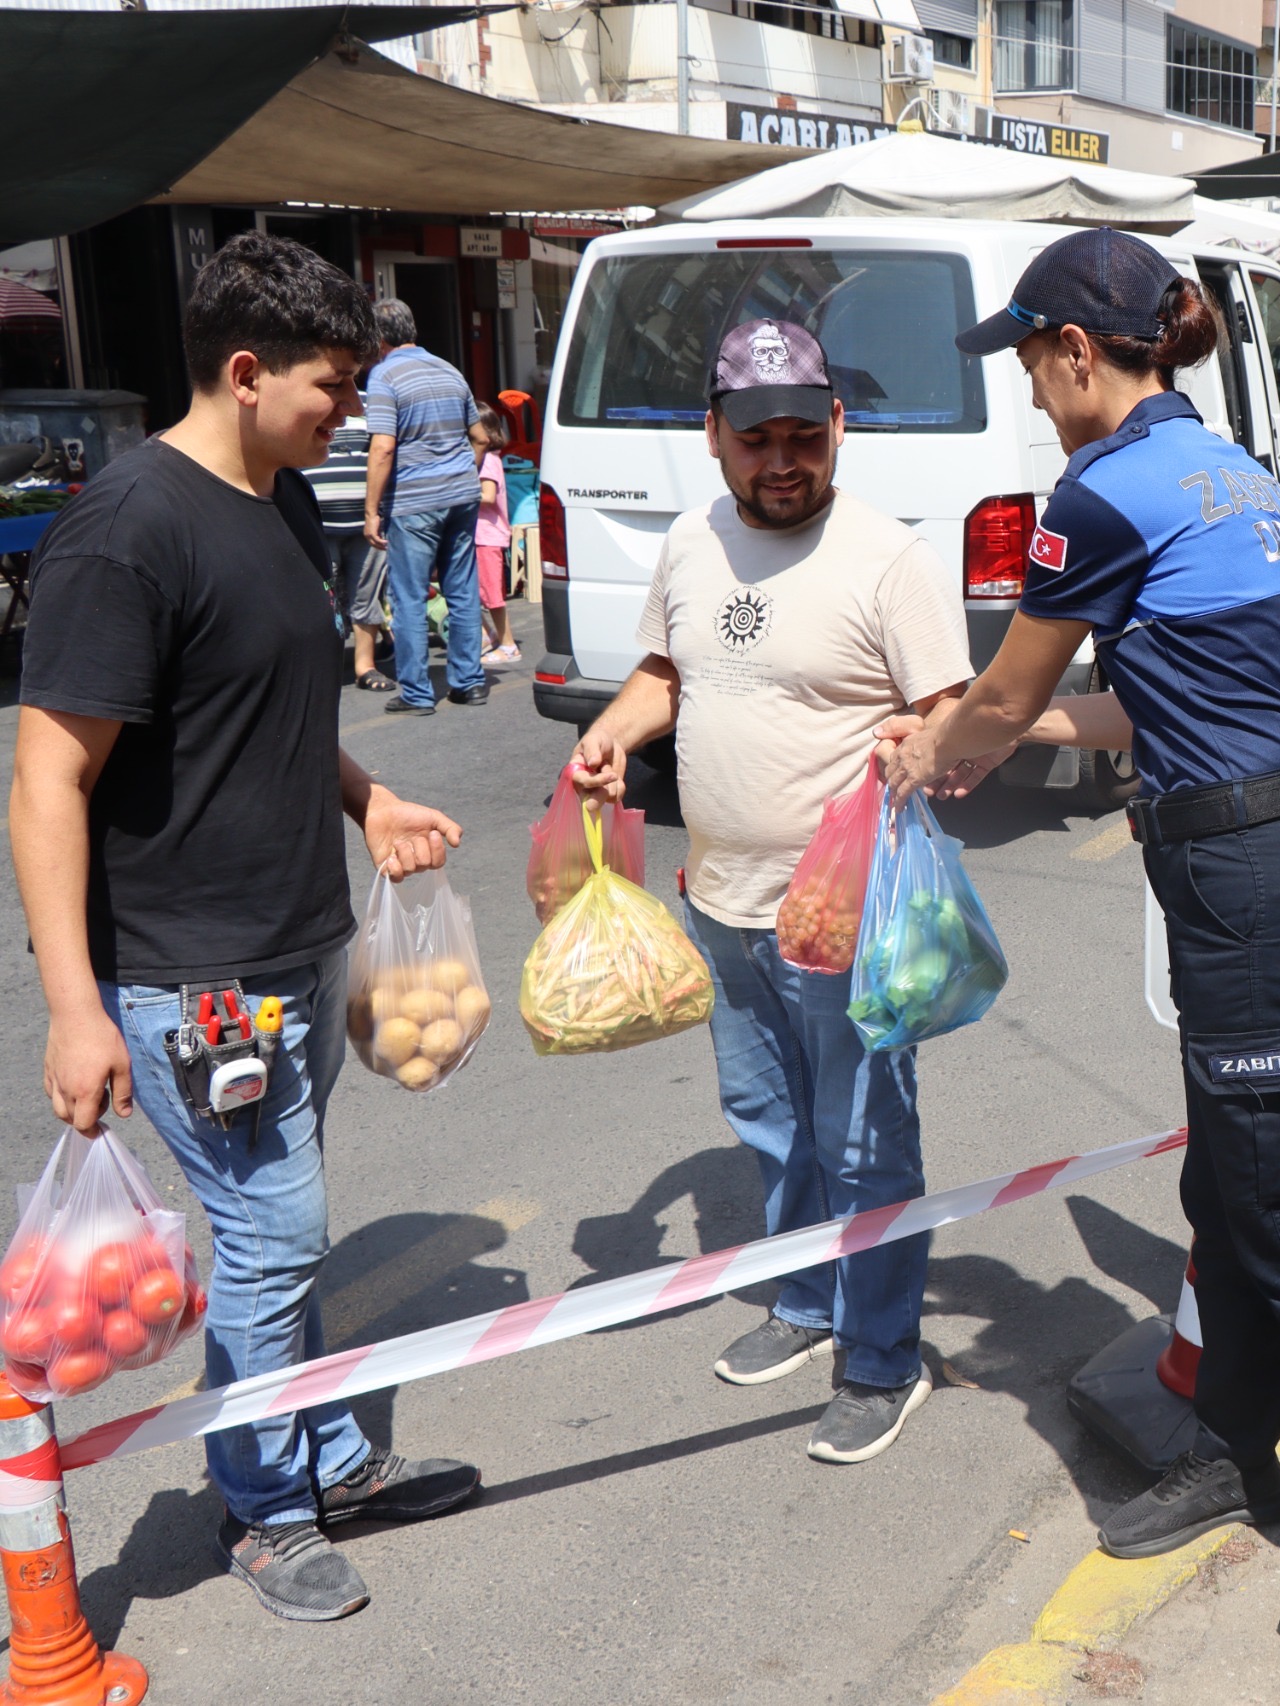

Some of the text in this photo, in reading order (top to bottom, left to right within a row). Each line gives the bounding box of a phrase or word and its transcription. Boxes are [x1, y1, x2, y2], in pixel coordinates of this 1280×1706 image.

[1002, 120, 1047, 154] USTA
[1050, 128, 1100, 160] ELLER
[567, 488, 648, 500] TRANSPORTER
